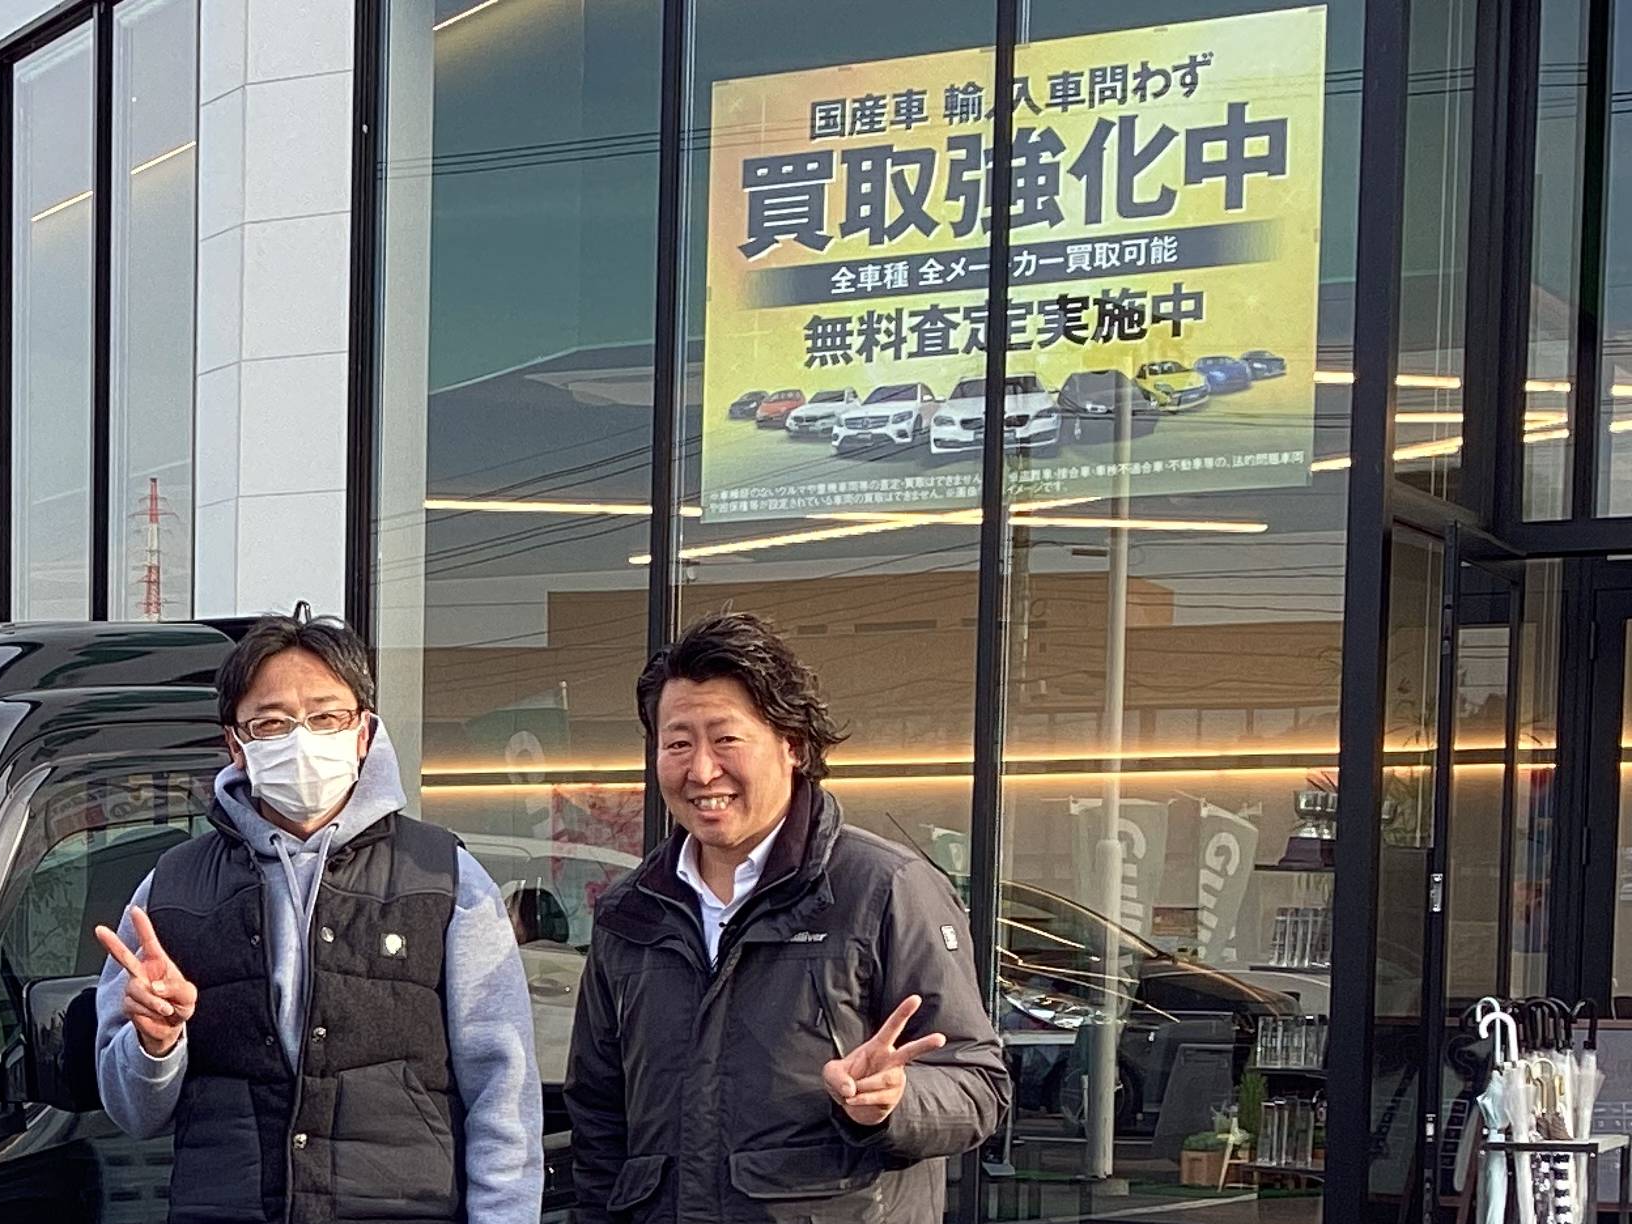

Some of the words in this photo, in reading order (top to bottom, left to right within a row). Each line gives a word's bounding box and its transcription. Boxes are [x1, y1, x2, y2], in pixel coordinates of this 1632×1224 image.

[809, 88, 929, 141] 国産車
[738, 101, 1288, 261] 買取強化中
[830, 260, 909, 294] 全車種
[918, 235, 1179, 287] 全メーカー買取可能
[803, 282, 1204, 368] 無料査定実施中
